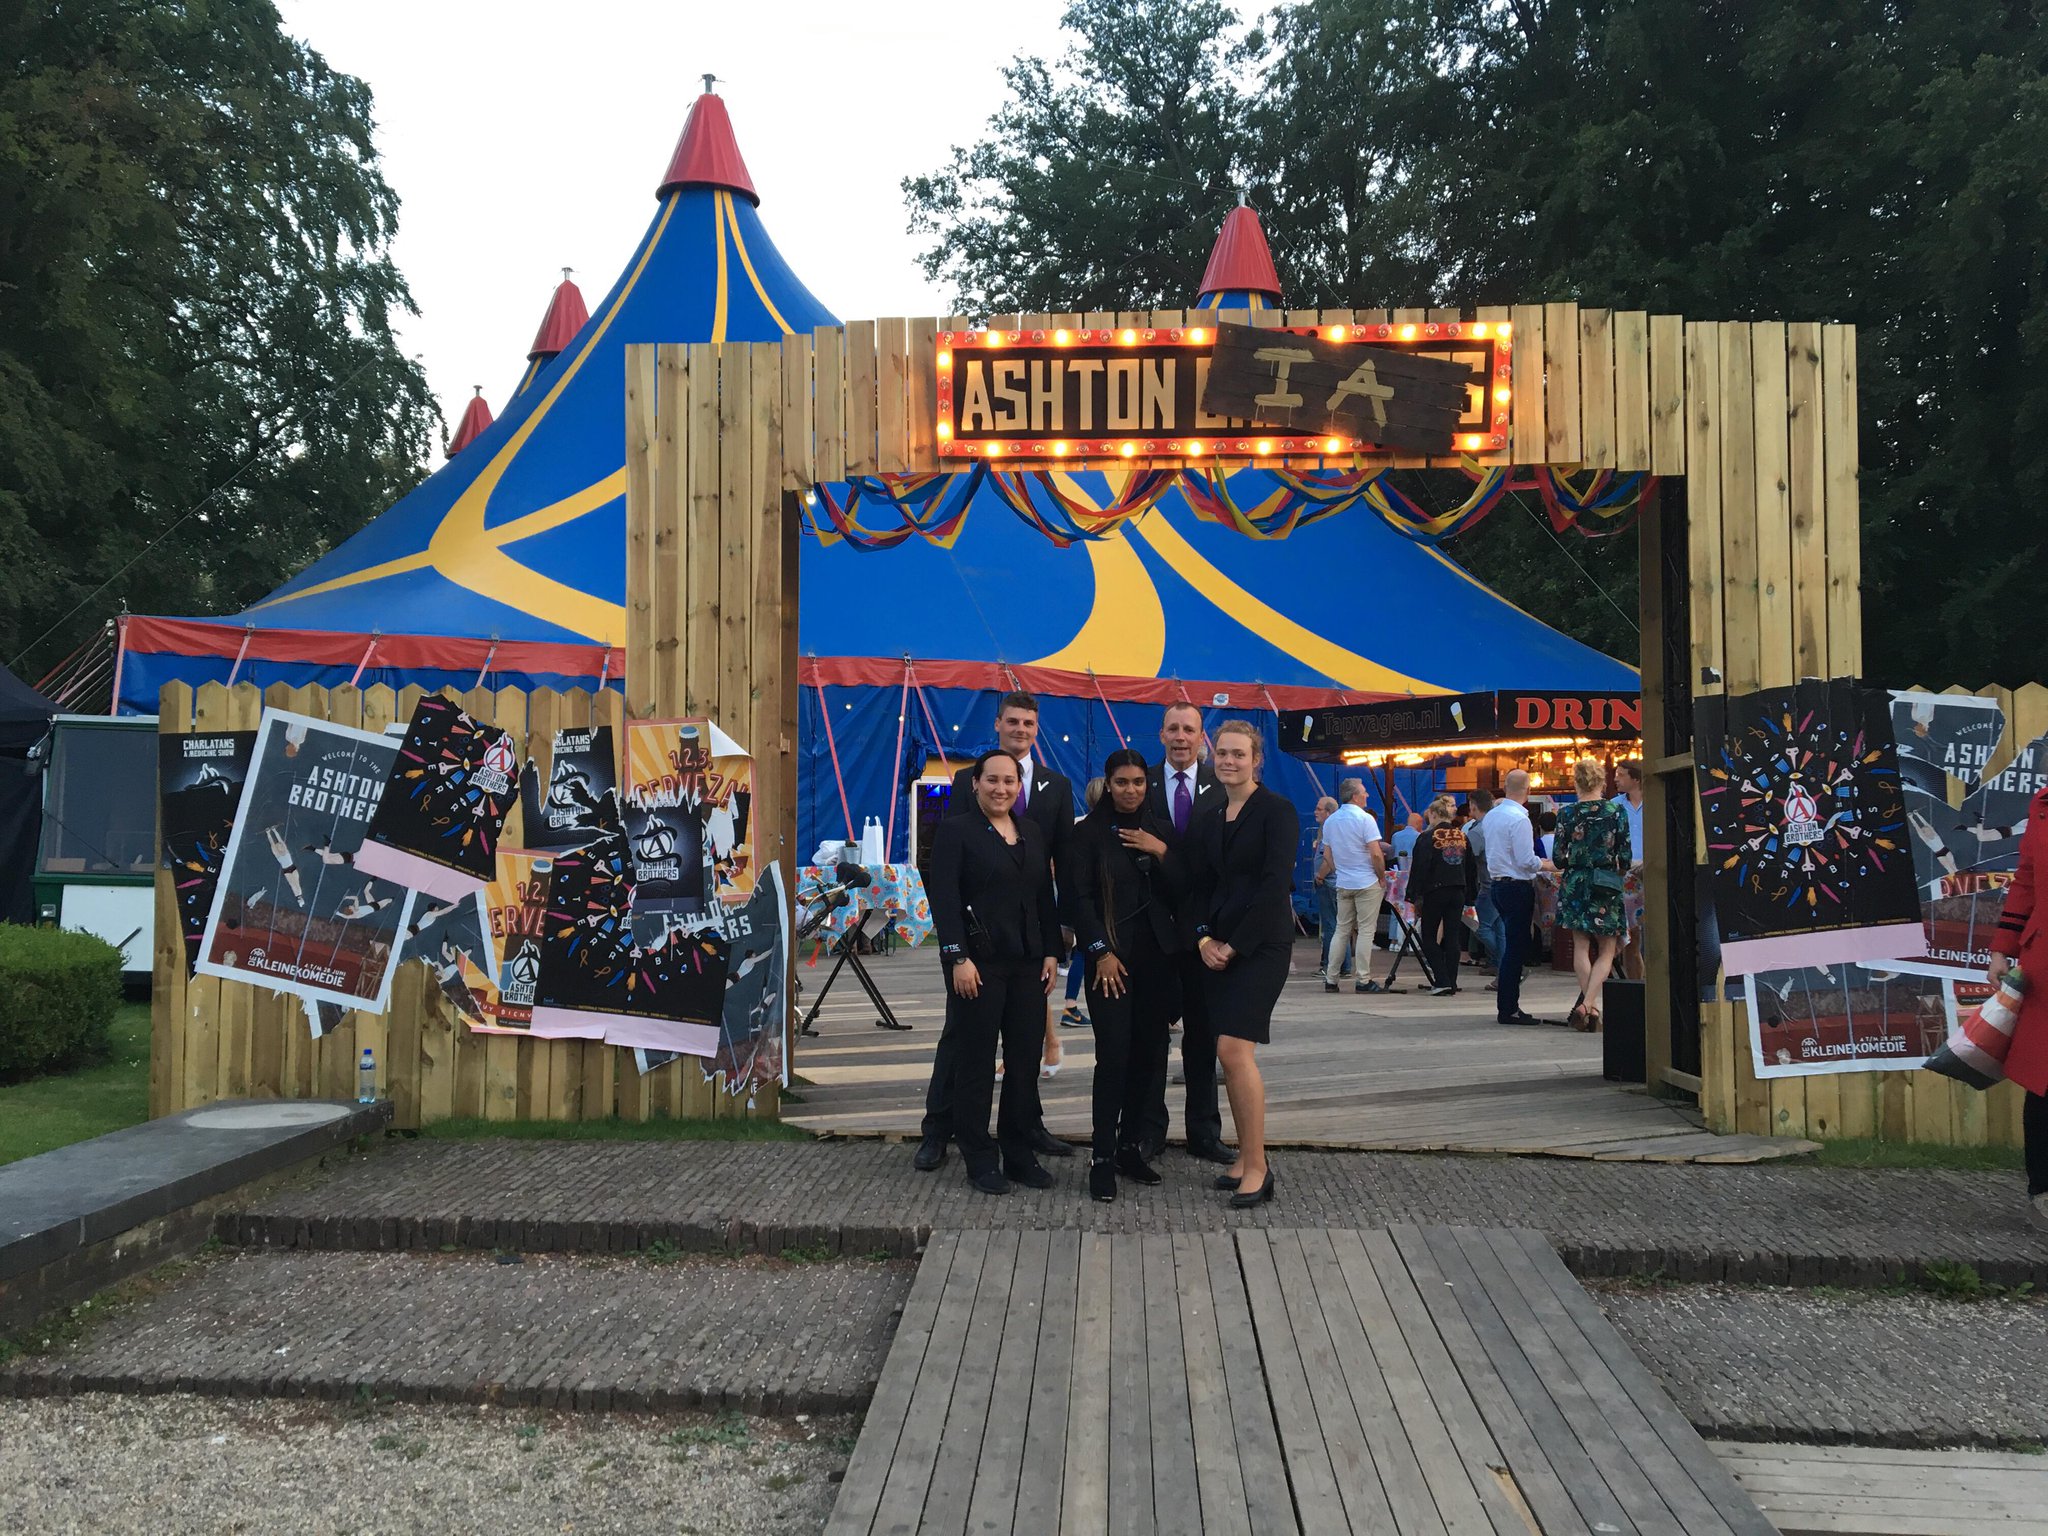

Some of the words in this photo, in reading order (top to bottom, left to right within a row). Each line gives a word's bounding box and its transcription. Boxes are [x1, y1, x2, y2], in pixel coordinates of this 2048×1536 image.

[961, 358, 1177, 432] ASHTON
[1322, 702, 1441, 738] Tapwagen.nl
[1513, 697, 1642, 731] DRIN
[183, 739, 235, 750] CHARLATANS
[189, 749, 217, 758] MEDICINE
[369, 761, 382, 775] THE
[479, 767, 507, 783] ASHTON
[307, 765, 386, 802] ASHTON
[472, 775, 508, 794] BROTHERS
[1789, 822, 1817, 833] ASHTON
[1785, 831, 1823, 843] BROTHERS
[643, 860, 672, 870] ASHTON
[638, 869, 678, 880] BROTHERS
